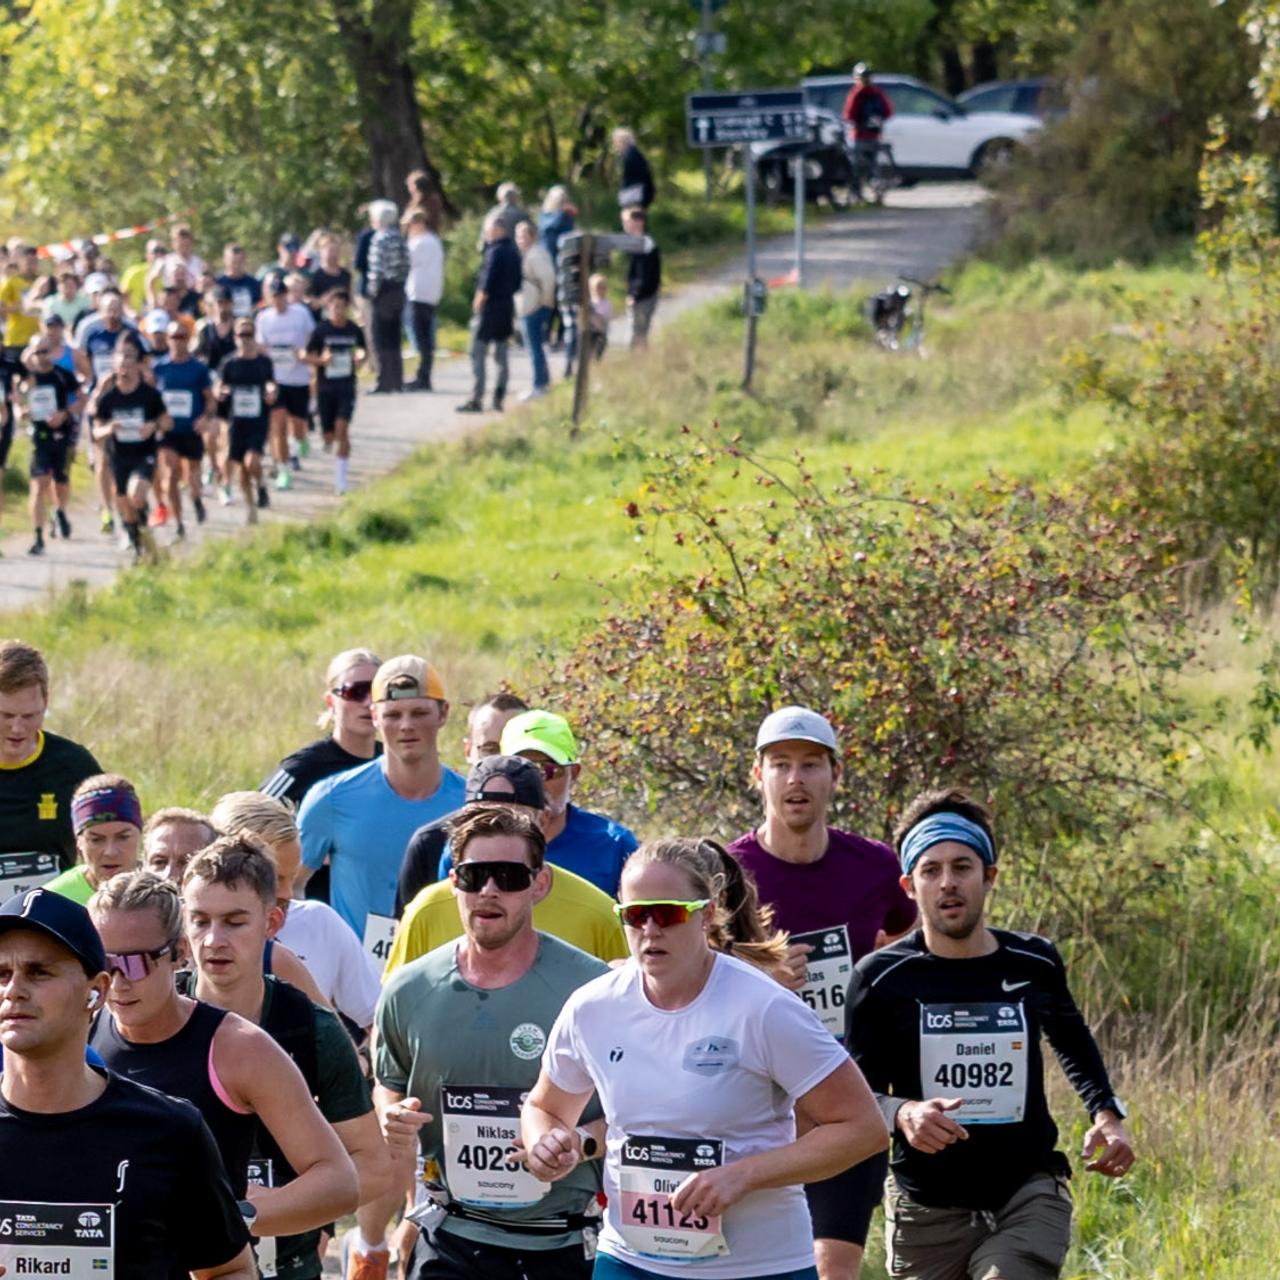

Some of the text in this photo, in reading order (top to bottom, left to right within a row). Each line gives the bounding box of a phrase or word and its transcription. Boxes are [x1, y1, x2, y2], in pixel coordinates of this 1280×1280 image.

[807, 971, 825, 984] las
[801, 984, 845, 1011] 516
[927, 1012, 953, 1028] tcs
[956, 1042, 996, 1056] Daniel
[934, 1062, 1013, 1088] 40982
[447, 1092, 472, 1109] tcs
[476, 1126, 516, 1139] Niklas
[457, 1145, 530, 1172] 4023
[625, 1142, 649, 1161] tcs
[73, 1229, 104, 1238] TATA
[16, 1257, 71, 1274] Rikard
